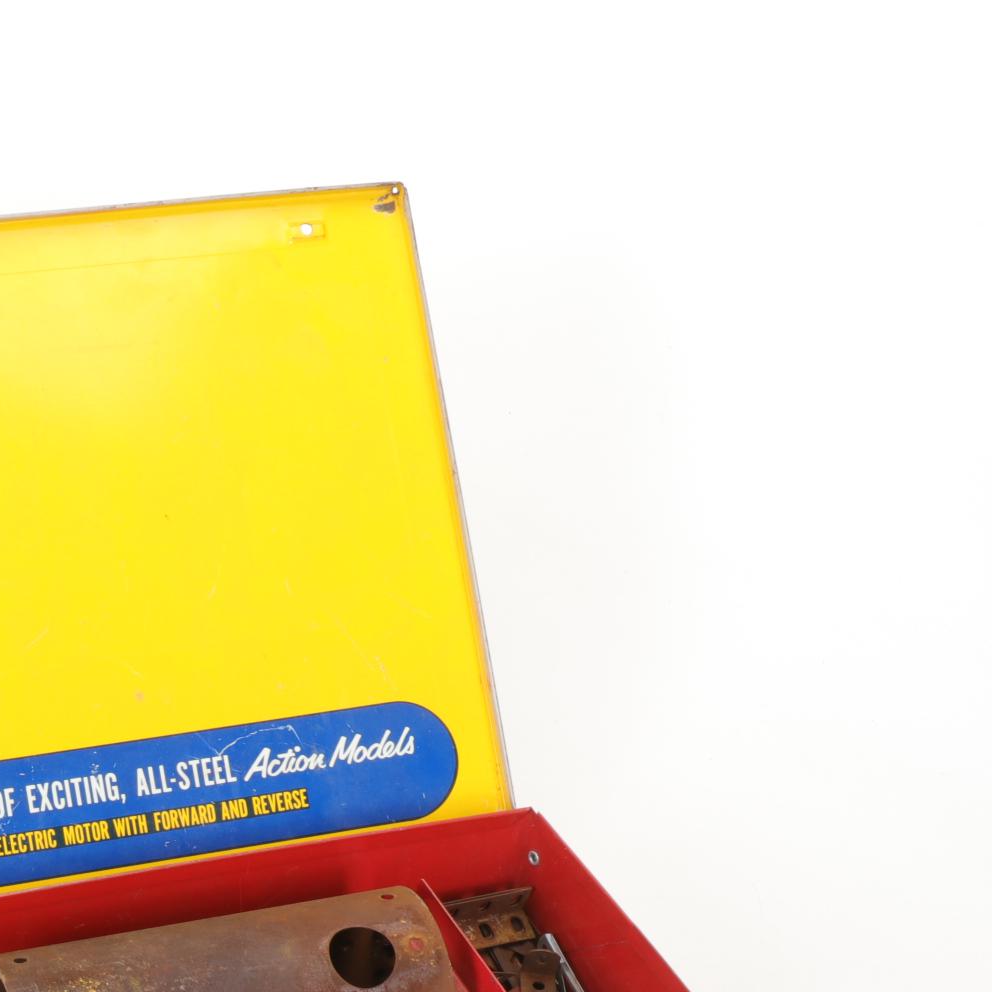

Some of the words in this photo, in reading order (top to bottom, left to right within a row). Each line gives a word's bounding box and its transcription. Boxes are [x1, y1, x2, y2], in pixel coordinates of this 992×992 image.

[25, 771, 126, 814] EXCITING,
[136, 754, 237, 798] ALL-STEEL
[244, 746, 326, 782] Action
[329, 726, 415, 768] Models
[63, 820, 110, 846] MOTOR
[112, 813, 149, 837] WITH
[153, 802, 216, 831] FORWARD
[221, 798, 248, 821] AND
[251, 789, 309, 816] REVERSE
